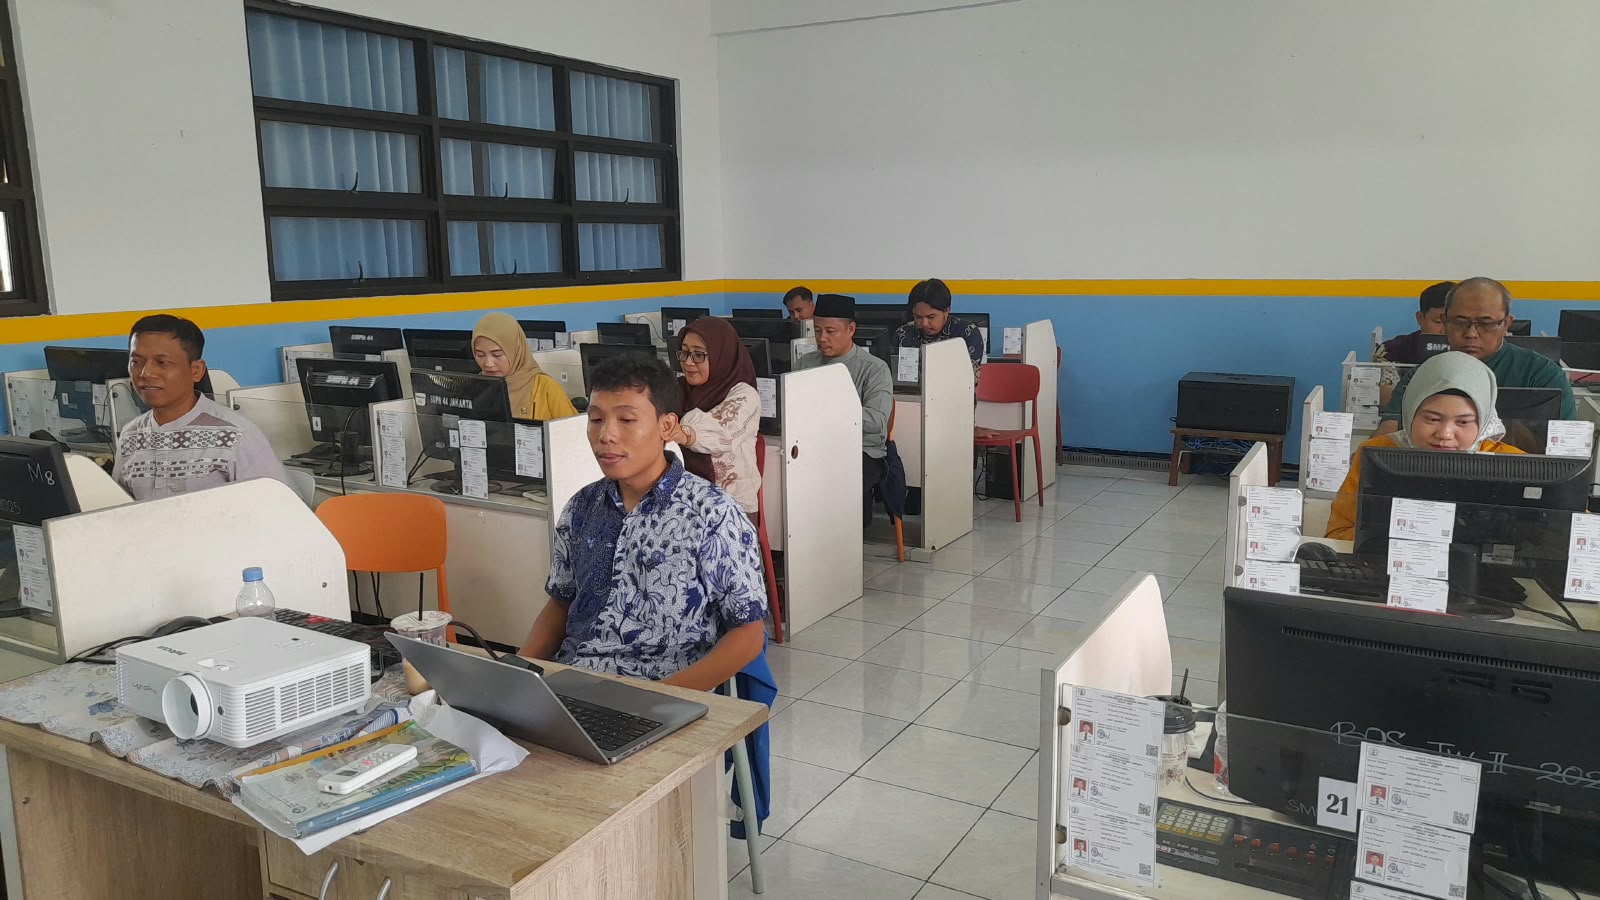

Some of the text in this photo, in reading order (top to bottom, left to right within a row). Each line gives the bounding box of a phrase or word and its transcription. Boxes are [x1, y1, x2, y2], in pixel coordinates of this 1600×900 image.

[442, 396, 449, 406] 44
[449, 397, 473, 410] JAKARTA
[1286, 798, 1318, 817] SM
[1325, 793, 1349, 816] 21
